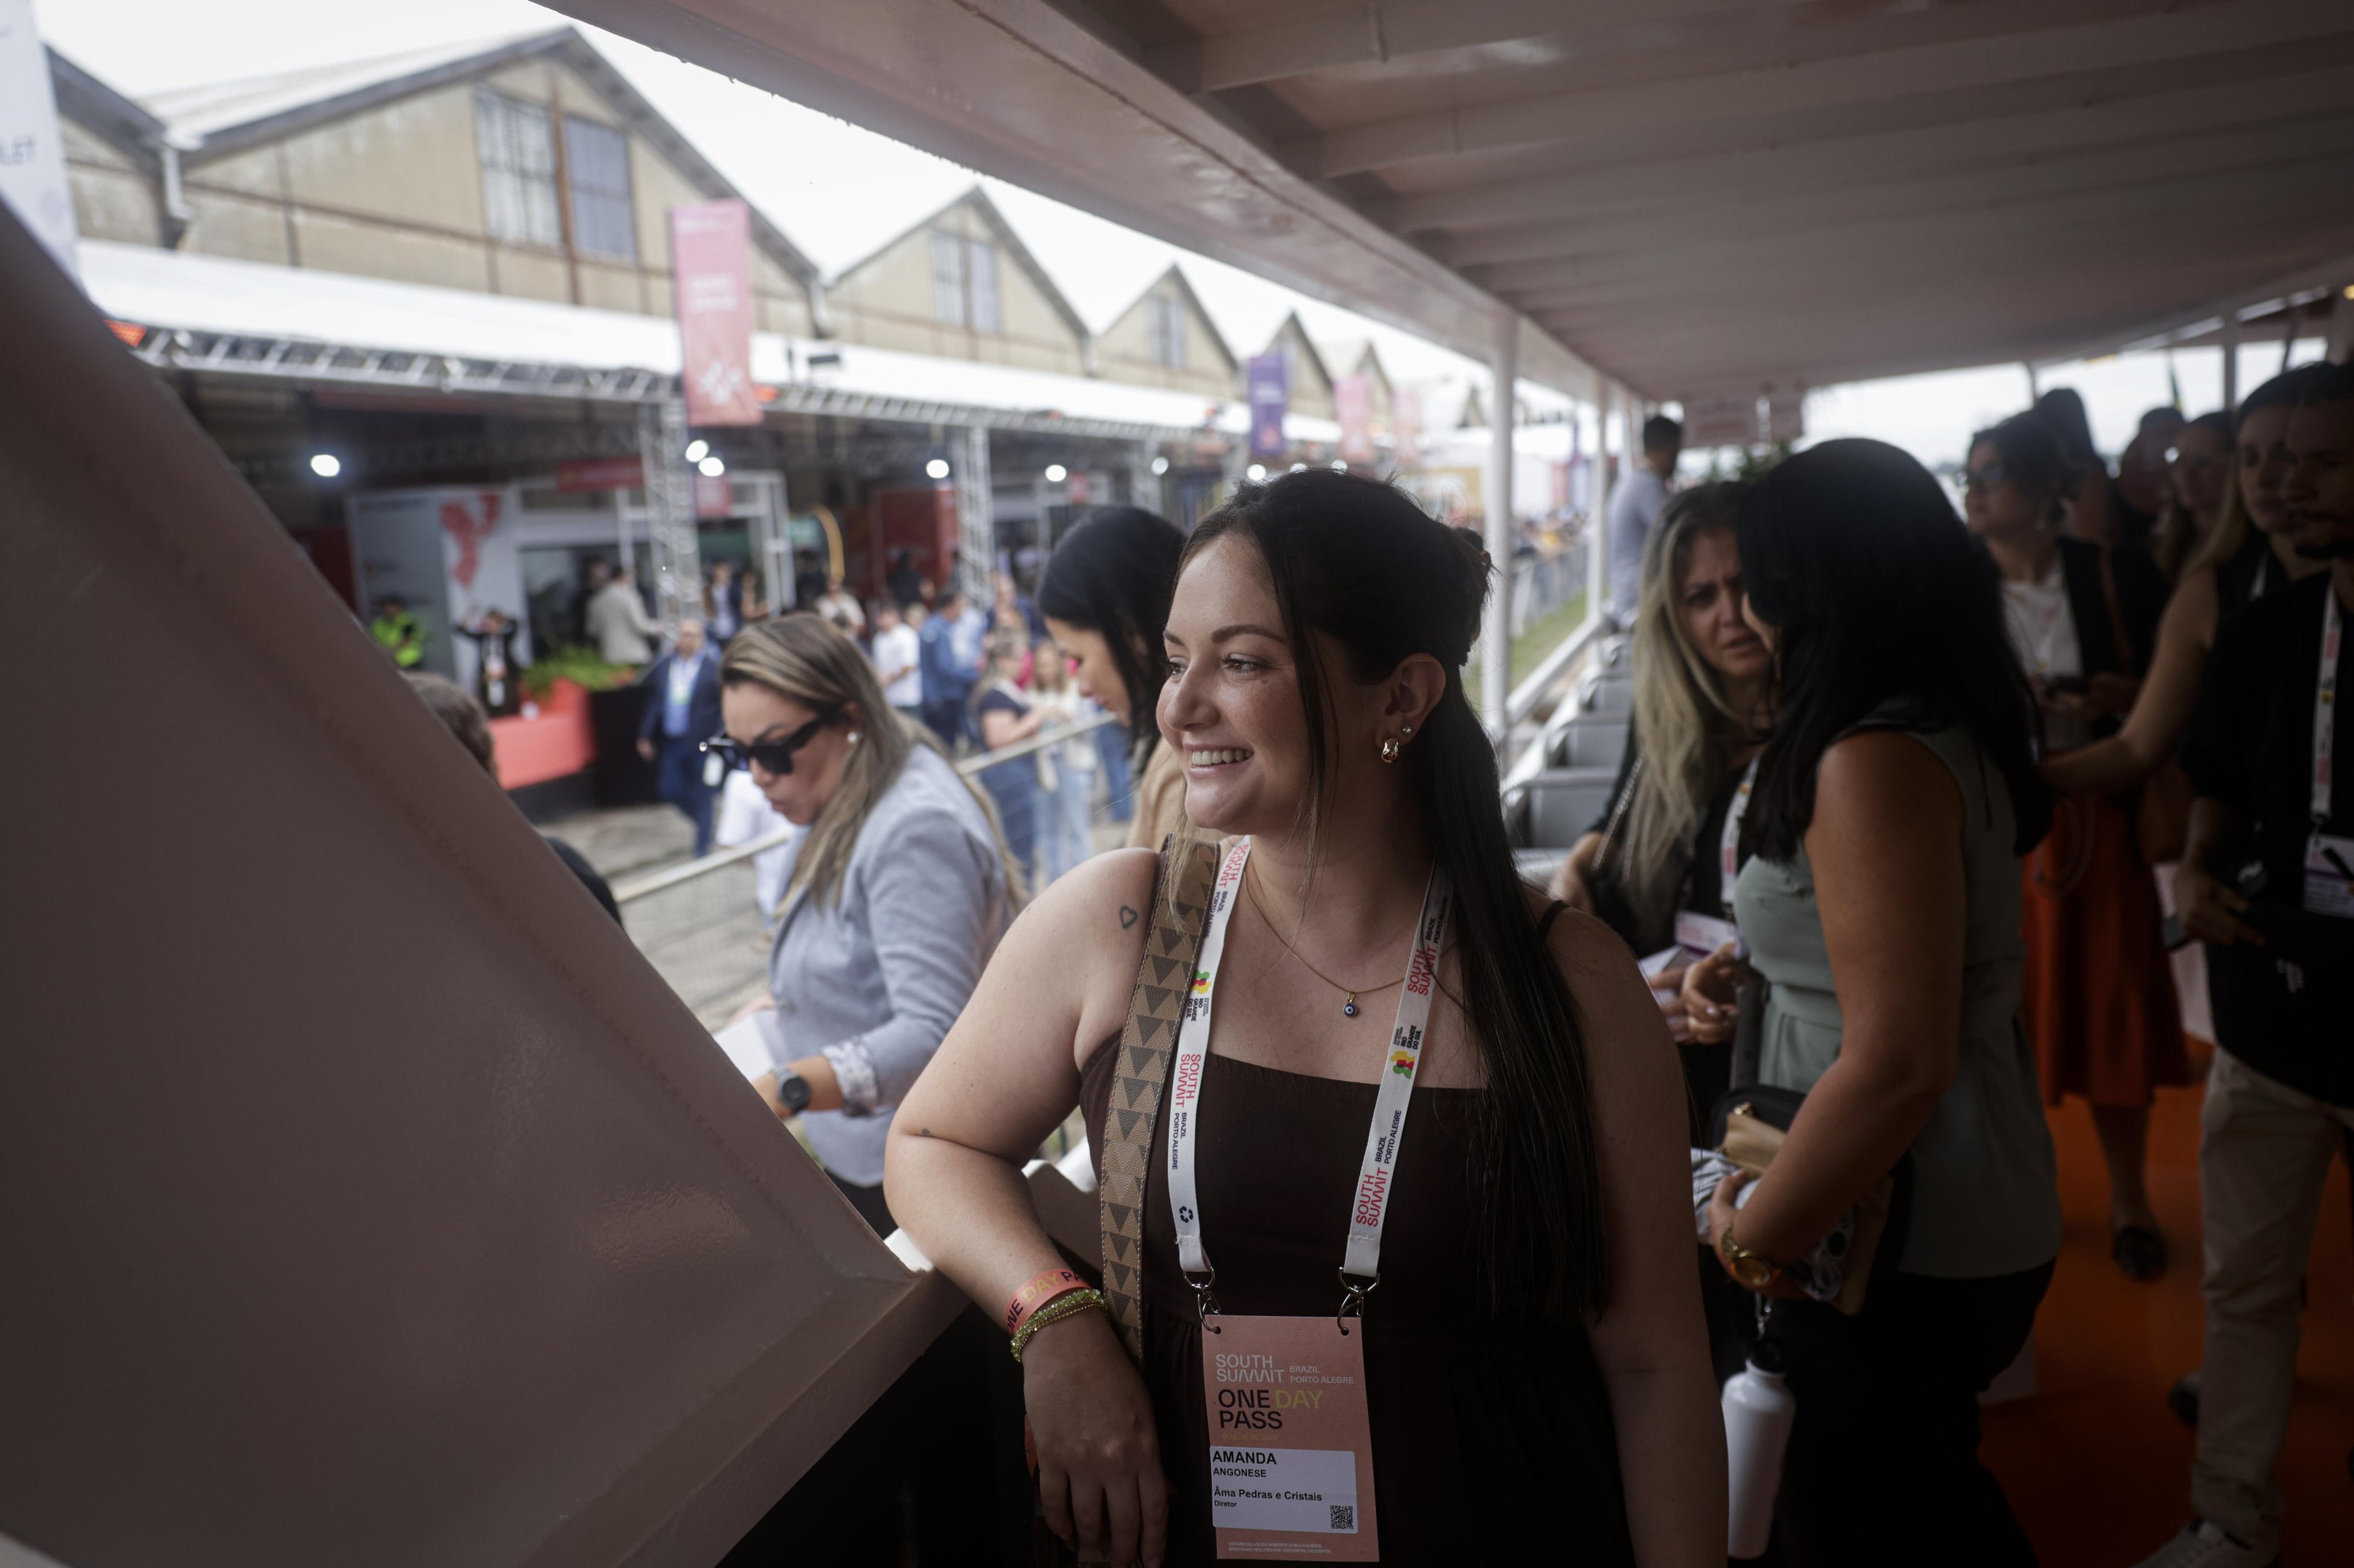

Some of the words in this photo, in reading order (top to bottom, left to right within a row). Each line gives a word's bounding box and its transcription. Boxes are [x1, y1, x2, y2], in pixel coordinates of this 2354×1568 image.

[1230, 844, 1249, 881] SOUTH
[1210, 891, 1221, 912] PORTO
[1217, 891, 1227, 913] BRAZIL
[1407, 949, 1426, 993] SOUTH
[1418, 944, 1437, 996] SUMMIT
[1188, 998, 1193, 1007] DO
[1407, 1024, 1417, 1048] GRANDE
[1413, 1040, 1419, 1050] DO
[1175, 1053, 1190, 1108] SUMMIT
[1185, 1053, 1201, 1099] SOUTH
[1384, 1138, 1395, 1164] PORTO
[1391, 1110, 1402, 1139] ALEGRE
[1375, 1136, 1387, 1163] BRAZIL
[1356, 1174, 1376, 1225] SOUTH
[1368, 1167, 1388, 1227] SUMMIT
[1022, 1273, 1059, 1302] DAY
[1216, 1354, 1272, 1368] SOUTH
[1217, 1369, 1285, 1383] SUMMIT
[1218, 1389, 1270, 1408] ONE
[1275, 1389, 1324, 1409] DAY
[1220, 1410, 1283, 1429] PASS
[1212, 1450, 1278, 1465] AMANDA
[1213, 1468, 1267, 1478] ANGONESE
[1214, 1485, 1236, 1498] Âma
[1238, 1489, 1272, 1500] Pedras
[1284, 1491, 1323, 1502] Cristais
[1214, 1500, 1238, 1508] Diretor
